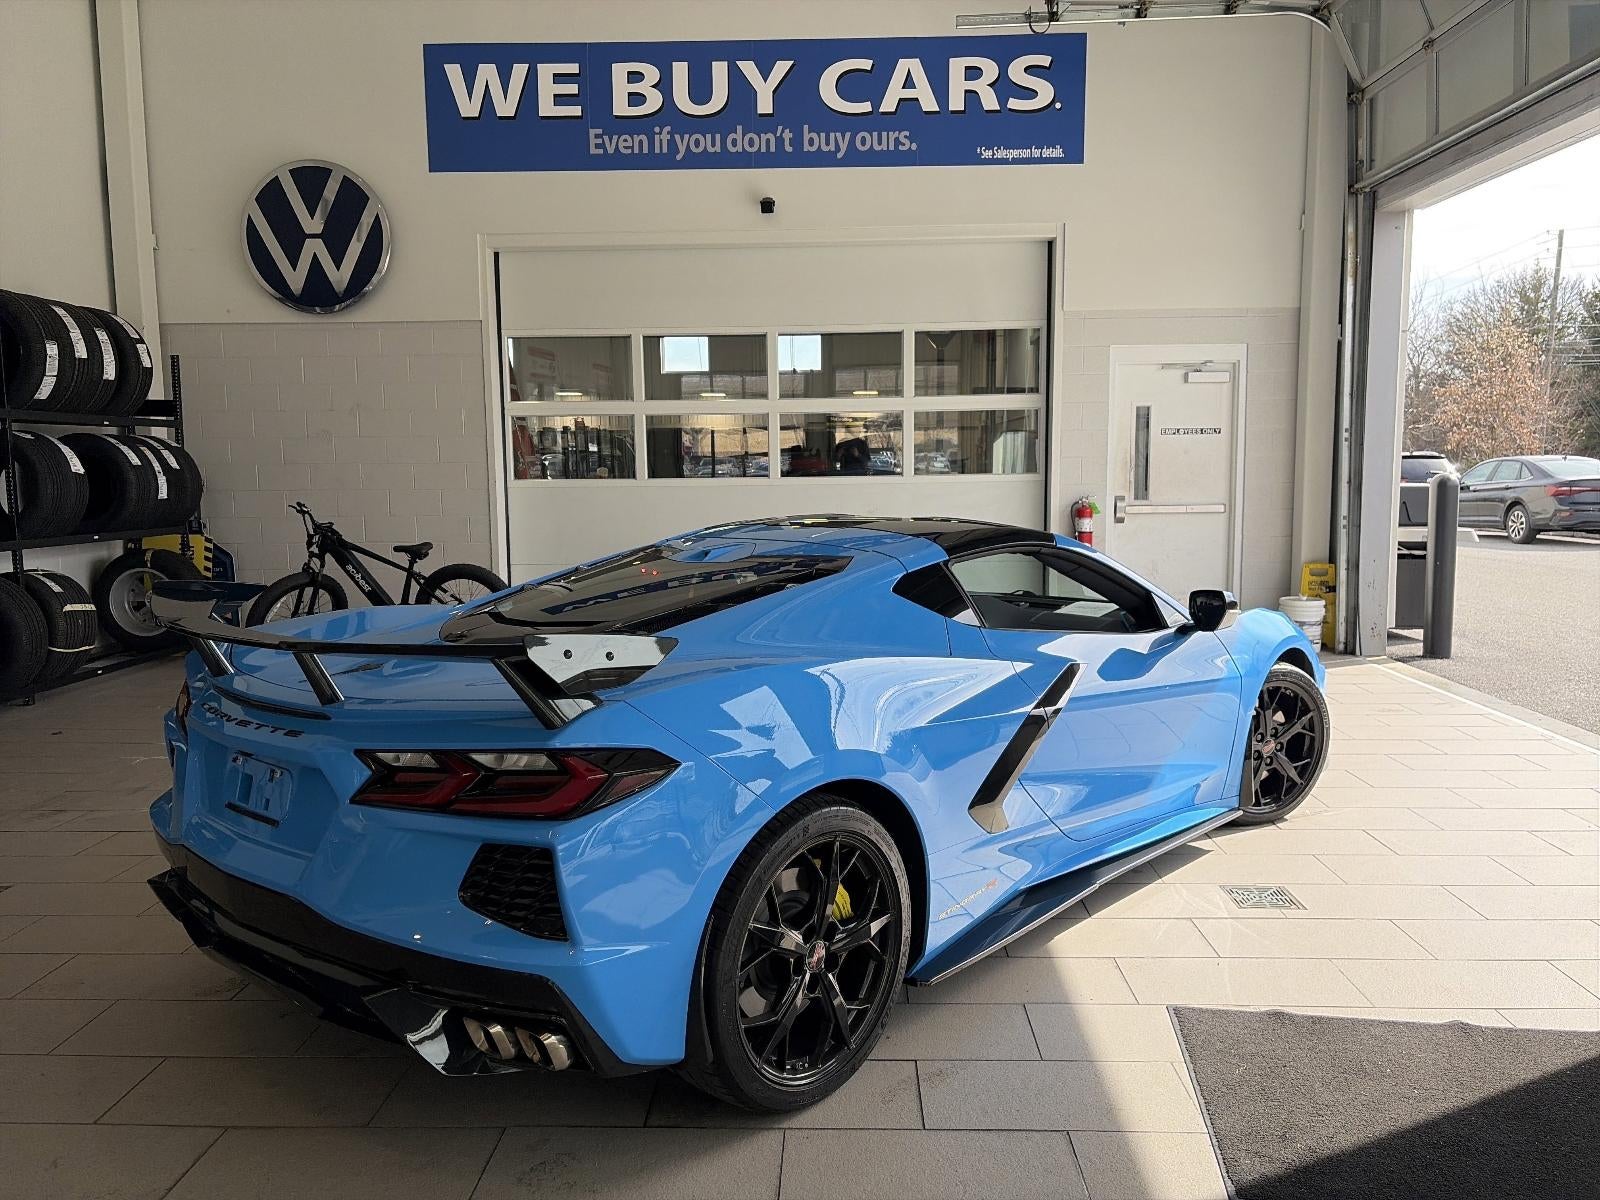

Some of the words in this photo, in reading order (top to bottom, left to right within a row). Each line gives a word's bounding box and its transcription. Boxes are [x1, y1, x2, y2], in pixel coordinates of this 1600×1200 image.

[443, 63, 583, 119] WE
[611, 60, 796, 118] BUY
[588, 128, 649, 154] Even
[653, 125, 671, 154] if
[674, 133, 721, 161] you
[726, 125, 793, 153] don't
[803, 125, 852, 159] buy
[855, 130, 918, 151] ours.
[993, 146, 1031, 161] Salesperson
[1032, 146, 1041, 157] for
[1042, 145, 1065, 157] details.
[201, 702, 305, 738] CORVETTE
